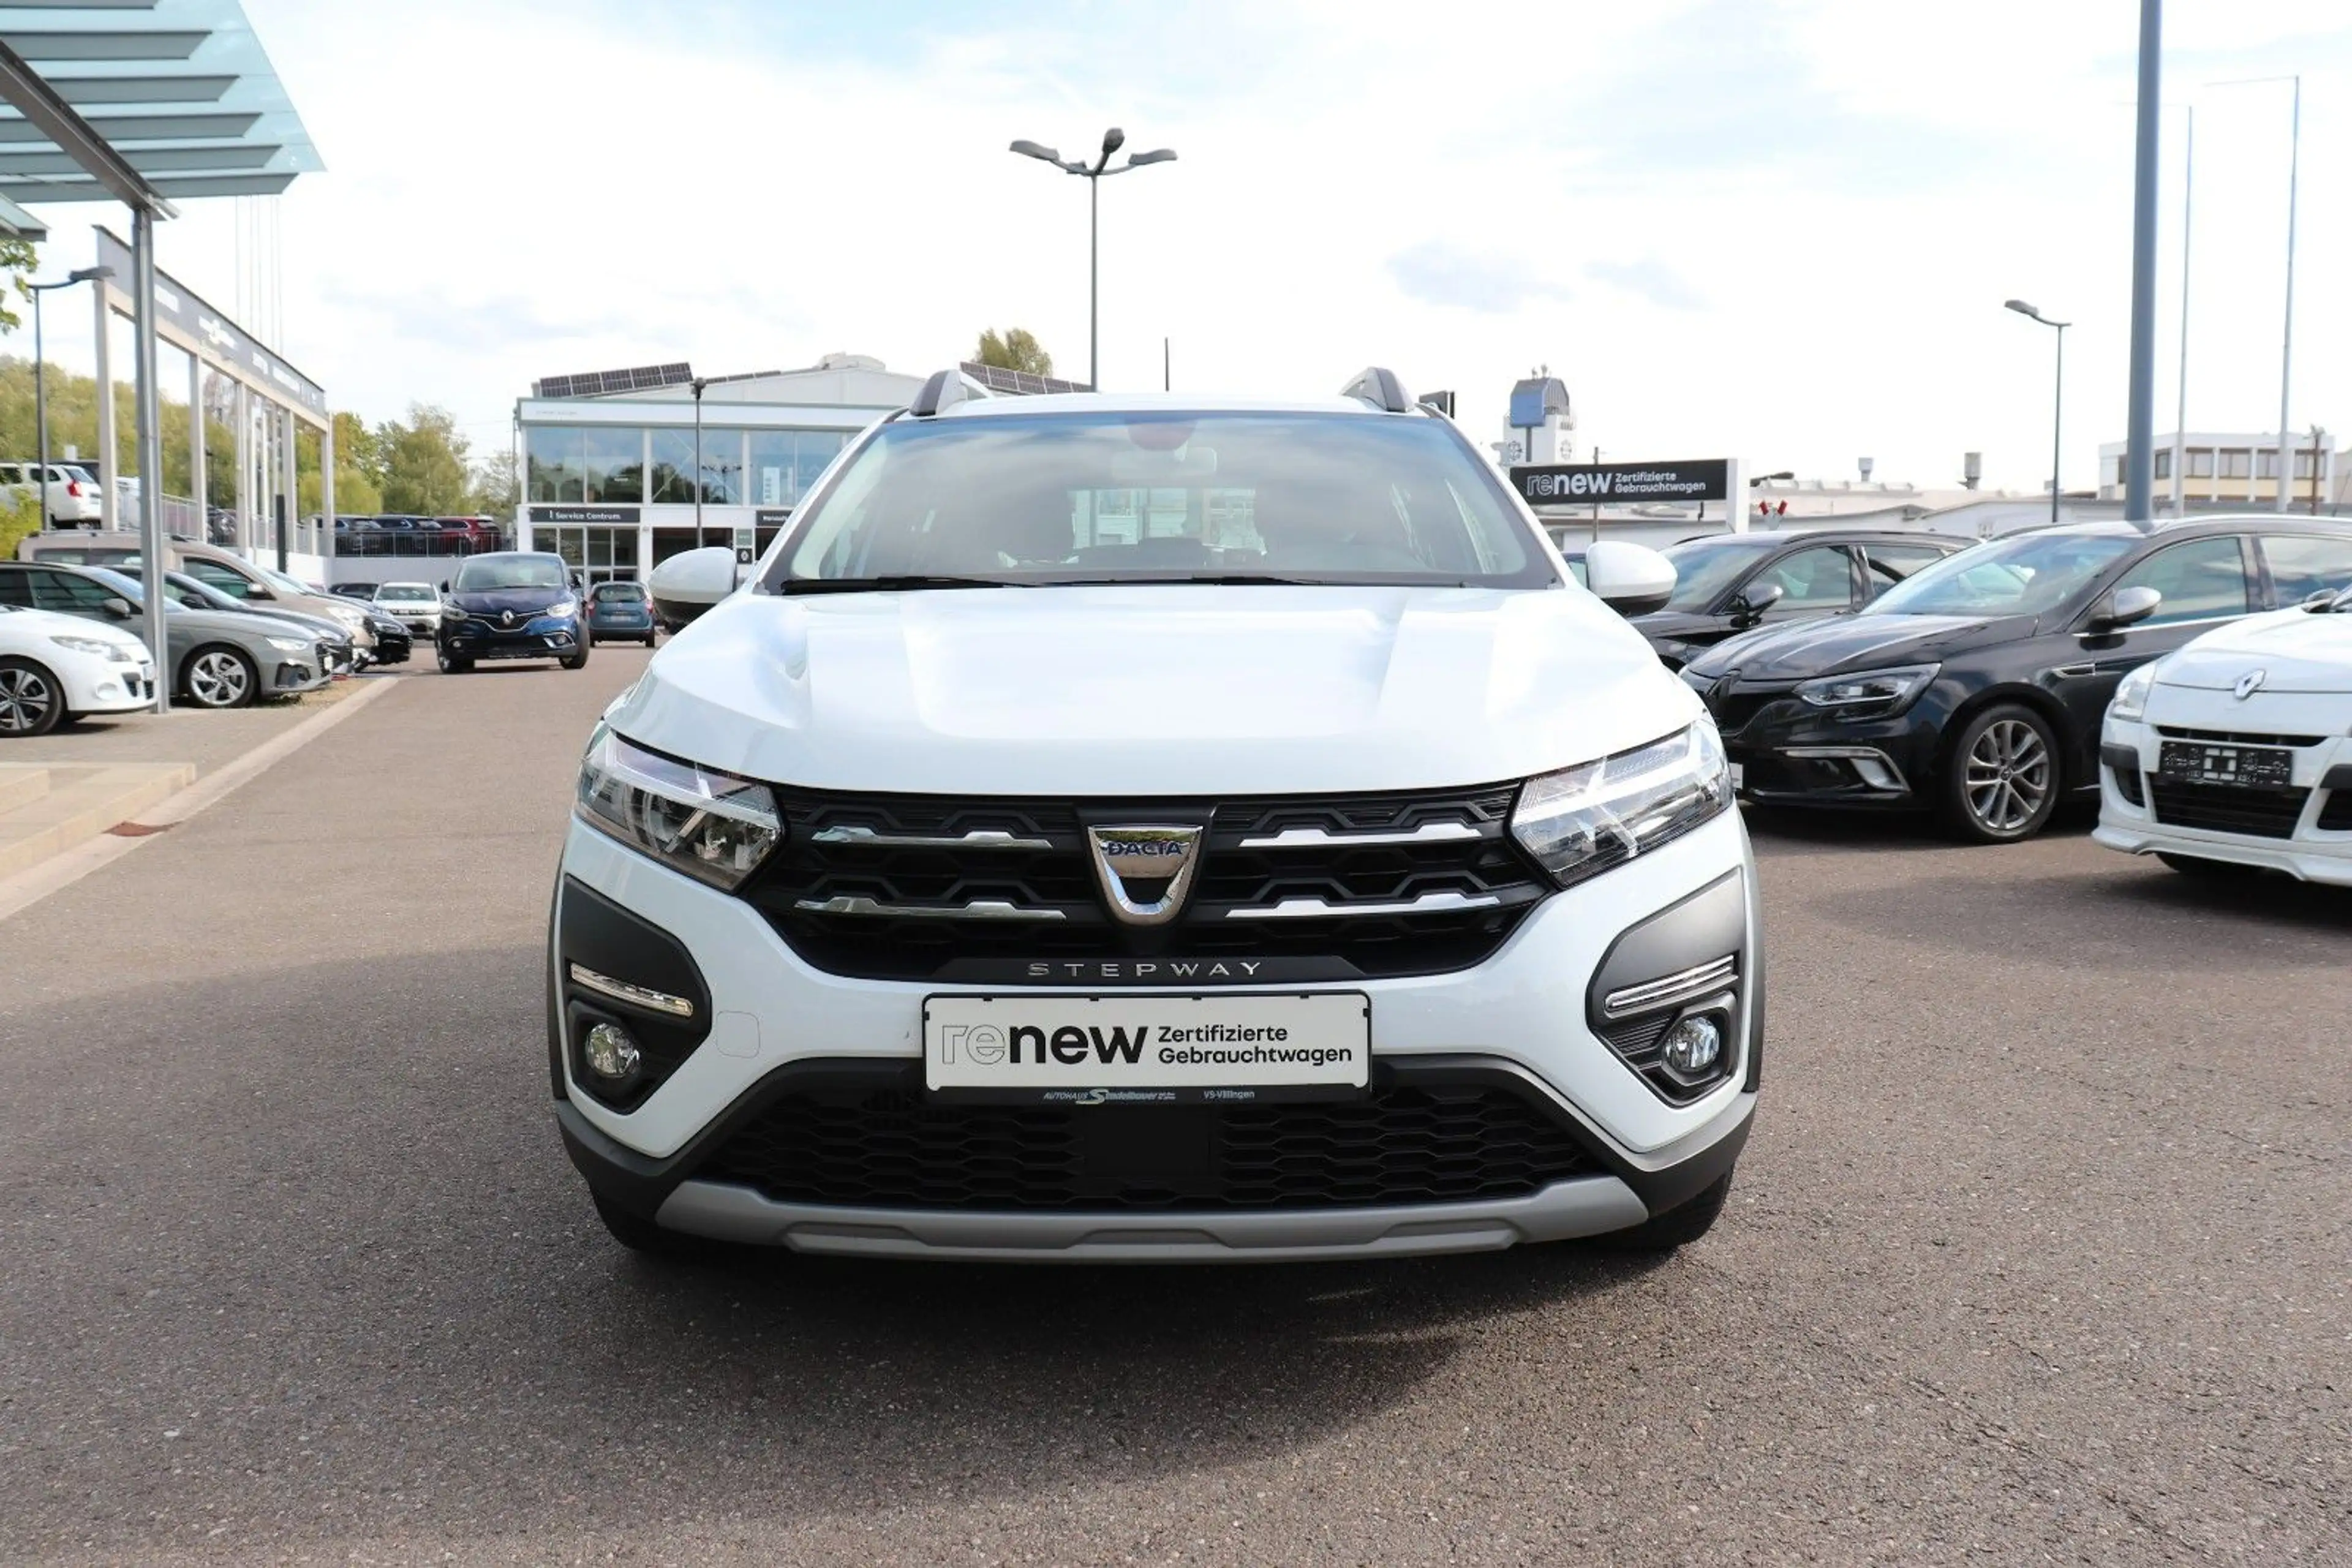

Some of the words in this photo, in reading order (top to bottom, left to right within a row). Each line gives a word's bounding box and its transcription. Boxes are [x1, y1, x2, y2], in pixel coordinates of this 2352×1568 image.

[1527, 473, 1612, 496] renew
[1615, 471, 1677, 483] Zertifizierte
[1615, 482, 1706, 494] Gebrauchtwagen
[1107, 842, 1183, 856] DACIA
[1027, 962, 1261, 978] STEPWAY
[1158, 1025, 1287, 1042] Zertifizierte
[941, 1025, 1148, 1065] renew
[1158, 1045, 1352, 1068] Gebrauchtwagen
